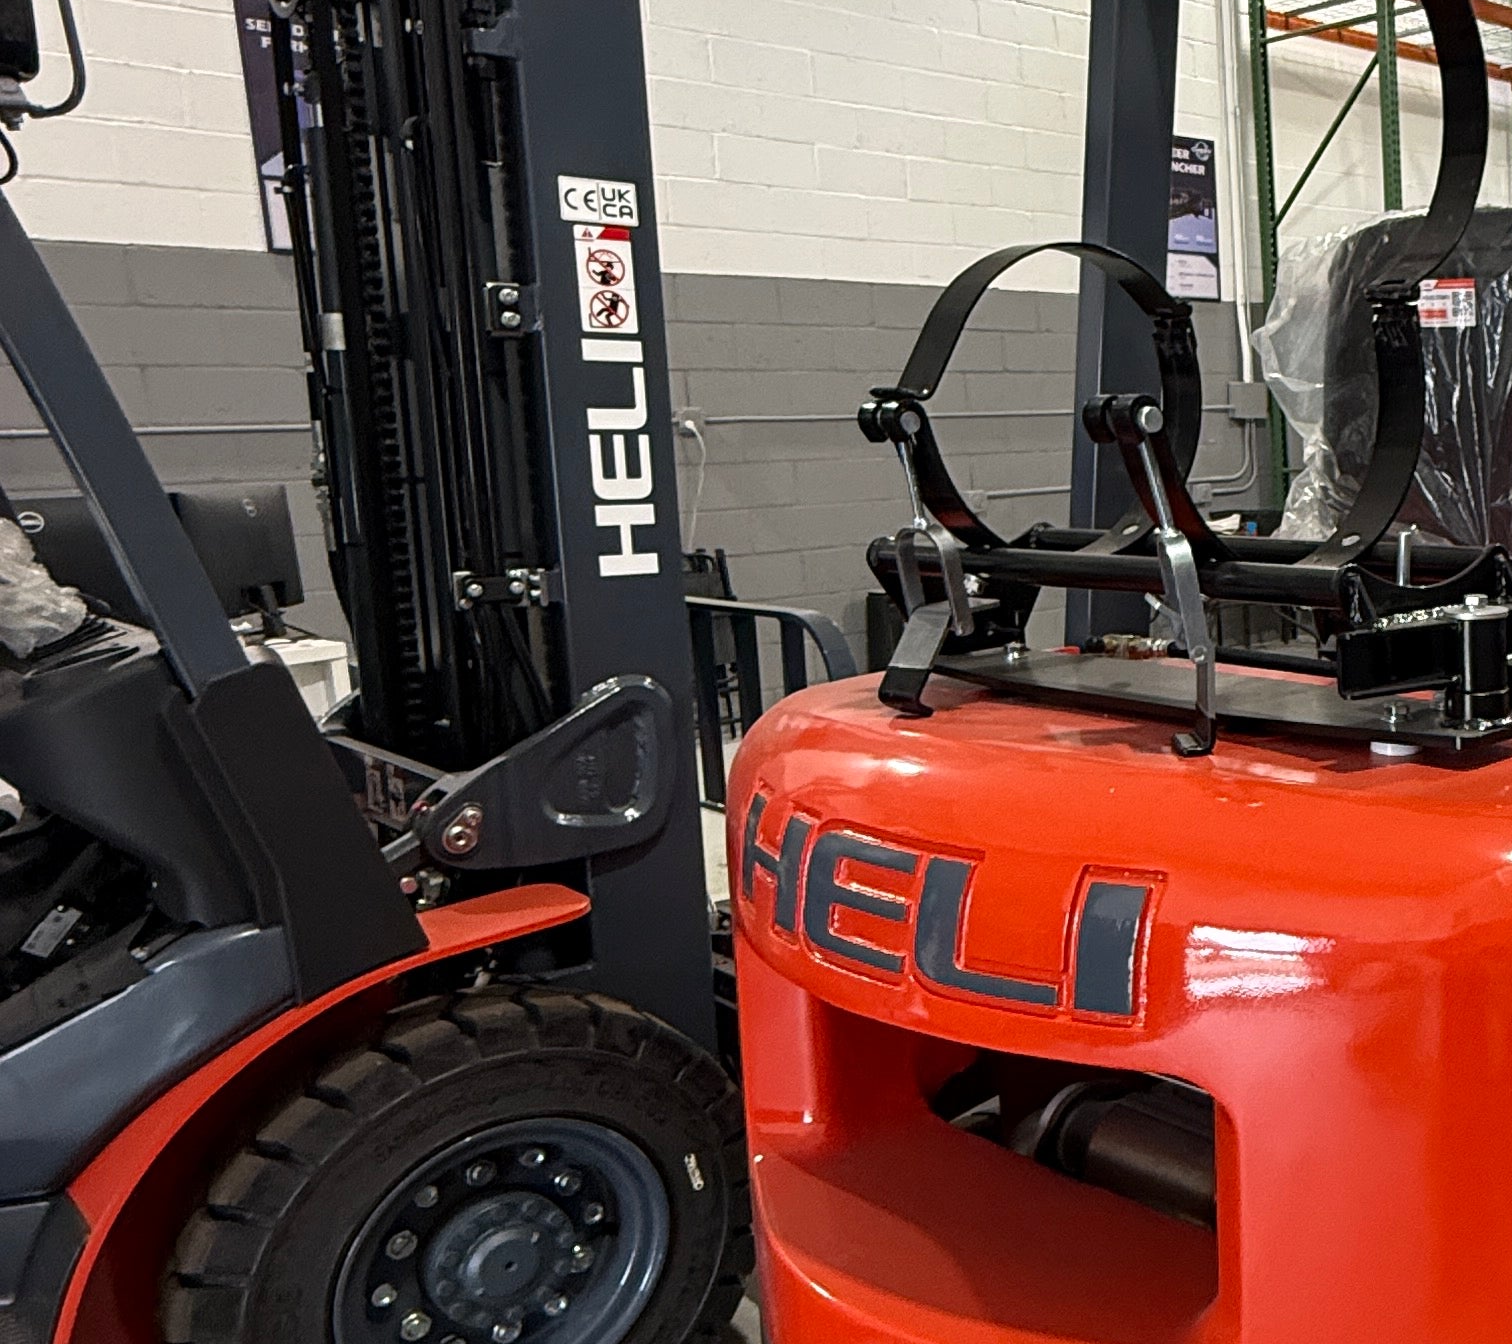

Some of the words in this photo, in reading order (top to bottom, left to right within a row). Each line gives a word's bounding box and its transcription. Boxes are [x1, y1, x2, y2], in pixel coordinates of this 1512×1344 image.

[1171, 161, 1205, 175] NCHER
[564, 187, 597, 212] CE
[601, 187, 631, 204] UK
[602, 203, 634, 220] CA
[581, 338, 660, 577] HELI
[742, 792, 1150, 1015] HELI
